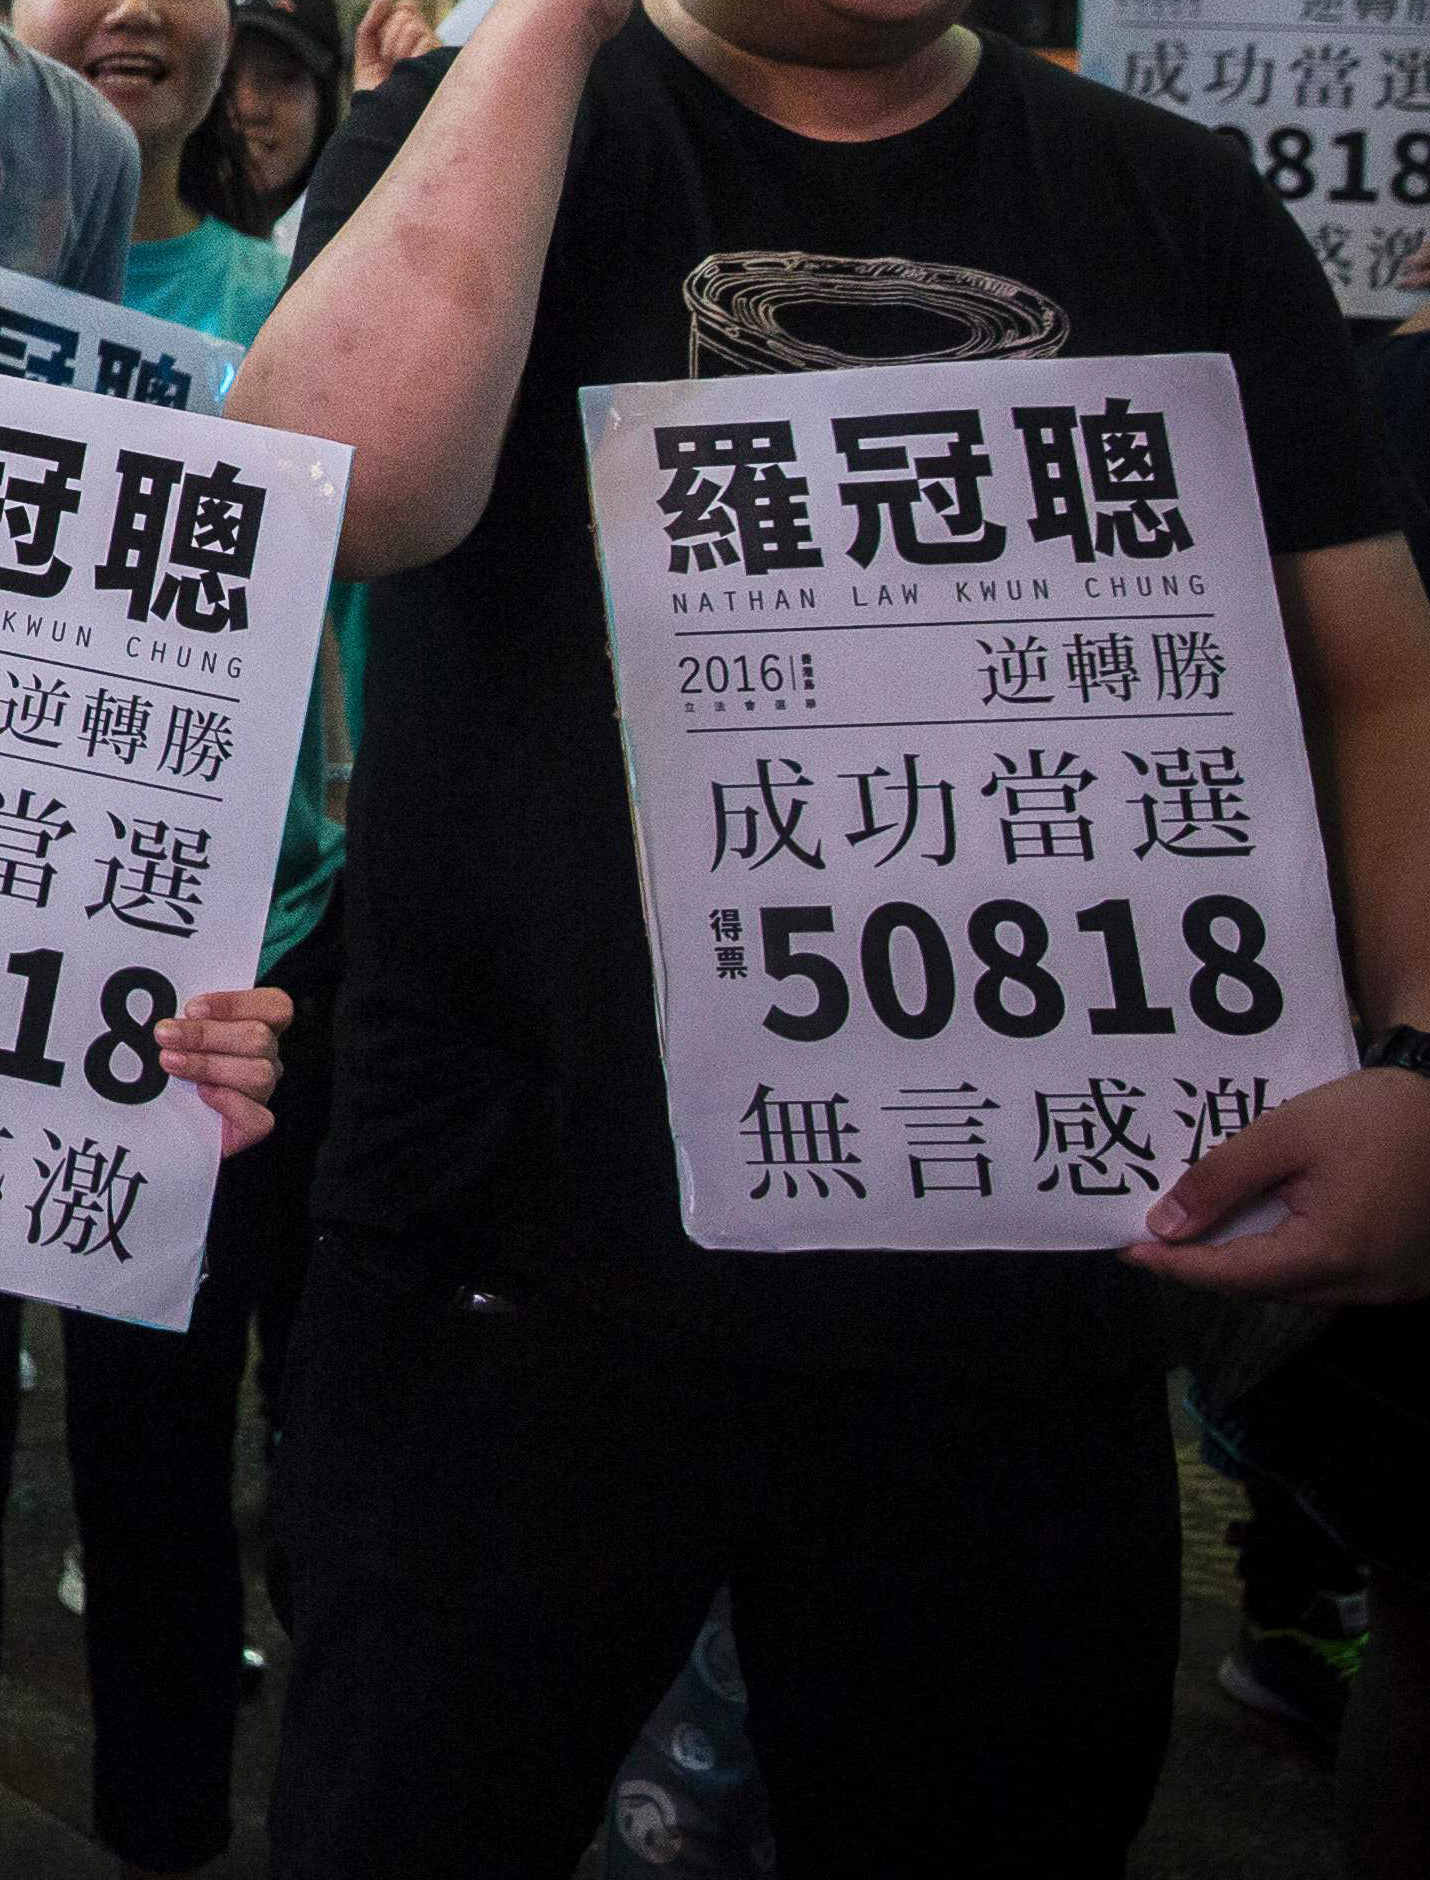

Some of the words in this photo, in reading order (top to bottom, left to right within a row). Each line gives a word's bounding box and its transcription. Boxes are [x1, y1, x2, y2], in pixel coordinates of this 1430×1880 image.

[654, 397, 1195, 576] 羅冠聰
[672, 586, 817, 615] NATHAN
[852, 582, 921, 608] LAW
[956, 578, 1051, 601] KWUN
[1086, 573, 1208, 598] CHUNG
[1, 609, 93, 648] KWUN
[125, 636, 244, 680] CHUNG
[678, 653, 784, 694] 2016
[976, 631, 1227, 707] 逆轉勝
[710, 746, 1257, 873] 成功當選
[710, 909, 748, 980] 得票
[759, 894, 1284, 1043] 50818
